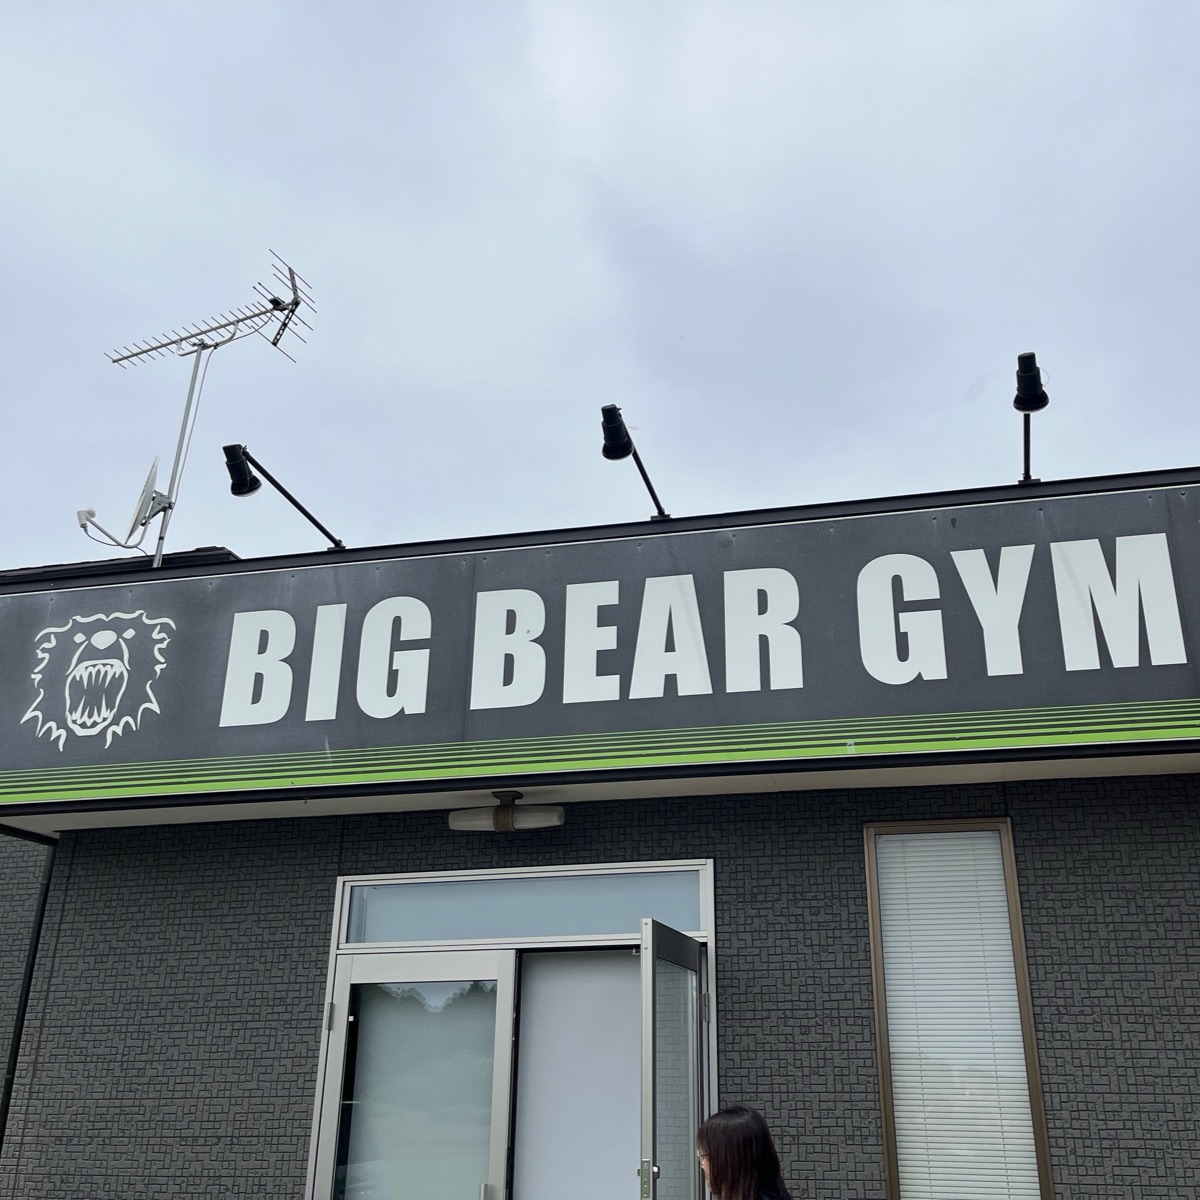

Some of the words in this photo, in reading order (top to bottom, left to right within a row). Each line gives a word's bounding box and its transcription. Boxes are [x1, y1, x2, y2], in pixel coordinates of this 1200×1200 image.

[219, 597, 432, 728] BIG
[470, 568, 804, 711] BEAR
[857, 533, 1188, 685] GYM
